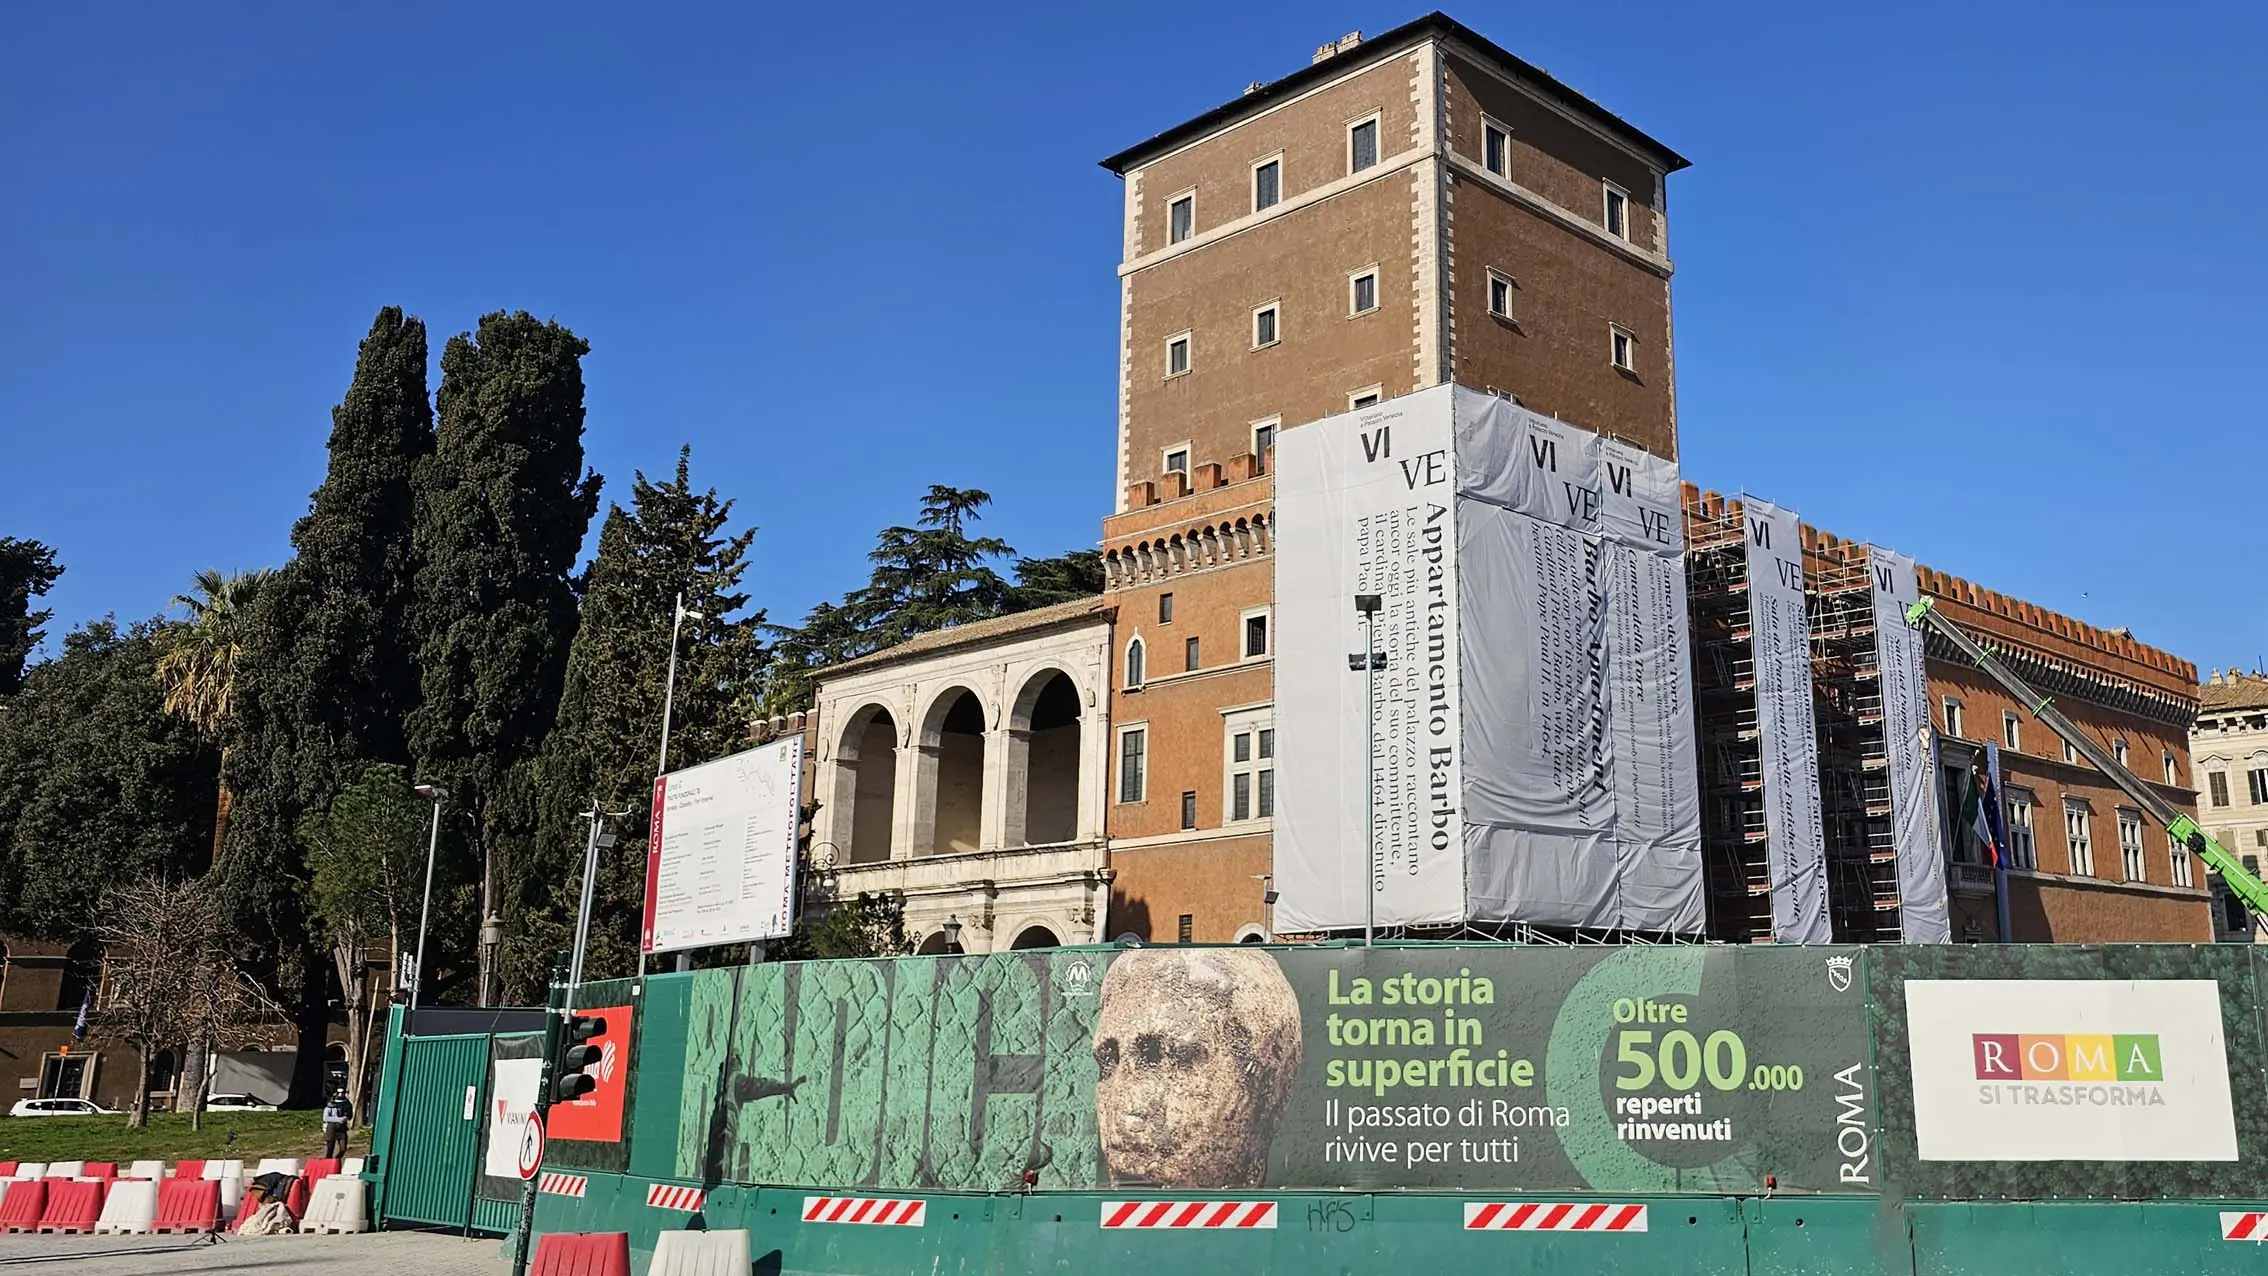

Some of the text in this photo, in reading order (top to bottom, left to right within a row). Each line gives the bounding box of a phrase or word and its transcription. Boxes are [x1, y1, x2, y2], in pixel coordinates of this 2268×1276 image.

[1360, 425, 1390, 463] VI
[1530, 434, 1556, 472] VI
[1398, 449, 1446, 491] VE
[1607, 461, 1632, 498] VI
[1562, 481, 1598, 523] VE
[1357, 517, 1370, 557] papa
[1555, 528, 1568, 556] tell
[1638, 506, 1671, 545] VE
[1750, 517, 1771, 550] VI
[1530, 521, 1546, 582] became
[1543, 526, 1561, 596] Cardinal
[1557, 557, 1569, 583] the
[1358, 561, 1372, 594] Pao
[1775, 556, 1802, 592] VE
[1875, 564, 1894, 594] VI
[1536, 583, 1548, 623] Pope
[1561, 586, 1572, 624] story
[1770, 595, 1780, 630] Sala
[1797, 604, 1806, 634] Sala
[1551, 598, 1563, 648] Pietro
[1563, 629, 1575, 649] of
[1628, 549, 1645, 703] Camera della Torre
[1662, 559, 1679, 717] Camera della Torre
[1540, 625, 1552, 665] Paul
[1564, 649, 1576, 670] its
[1894, 636, 1904, 667] Sala
[1421, 502, 1457, 851] Appartamento Barbo
[1567, 535, 1591, 827] The oldest rooms in the building still
[1581, 536, 1608, 793] Barbo Apartment
[1898, 669, 1907, 691] del
[1372, 513, 1388, 892] il cardinal Pietr Barbo, dal 1464 divenuto
[1388, 510, 1404, 866] ancor oggi la storia del suo committente,
[1404, 506, 1420, 877] Le sale più antiche del palazzo raccontano
[1541, 690, 1552, 708] in
[1775, 658, 1789, 738] Paramenti
[1802, 663, 1815, 741] Paramenti
[1563, 674, 1576, 742] original
[1553, 711, 1565, 746] who
[1781, 739, 1788, 749] o
[1900, 693, 1912, 771] Pappagallo
[1807, 743, 1814, 753] o
[1552, 749, 1565, 793] later
[1782, 751, 1792, 789] delle
[1808, 756, 1818, 792] delle
[652, 810, 662, 854] ROMA
[780, 737, 799, 932] ROMA METROPOLITANE
[1784, 791, 1796, 850] Fatiche
[1812, 796, 1823, 852] Fatiche
[1789, 852, 1799, 869] di
[1817, 874, 1828, 924] Ercole
[1327, 967, 1494, 1005] La storia
[1326, 1008, 1483, 1046] torna in
[1612, 997, 1688, 1024] Oltre
[1326, 1048, 1535, 1097] superficie
[1980, 1041, 2153, 1074] ROMA
[1616, 1092, 1702, 1120] reperti
[1978, 1085, 2166, 1106] SI TRASFORMA
[1325, 1098, 1571, 1134] Il passato di Roma
[1617, 1118, 1732, 1141] rinvenuti
[1833, 1062, 1871, 1184] ROMA
[1325, 1136, 1519, 1169] rivive per tutti
